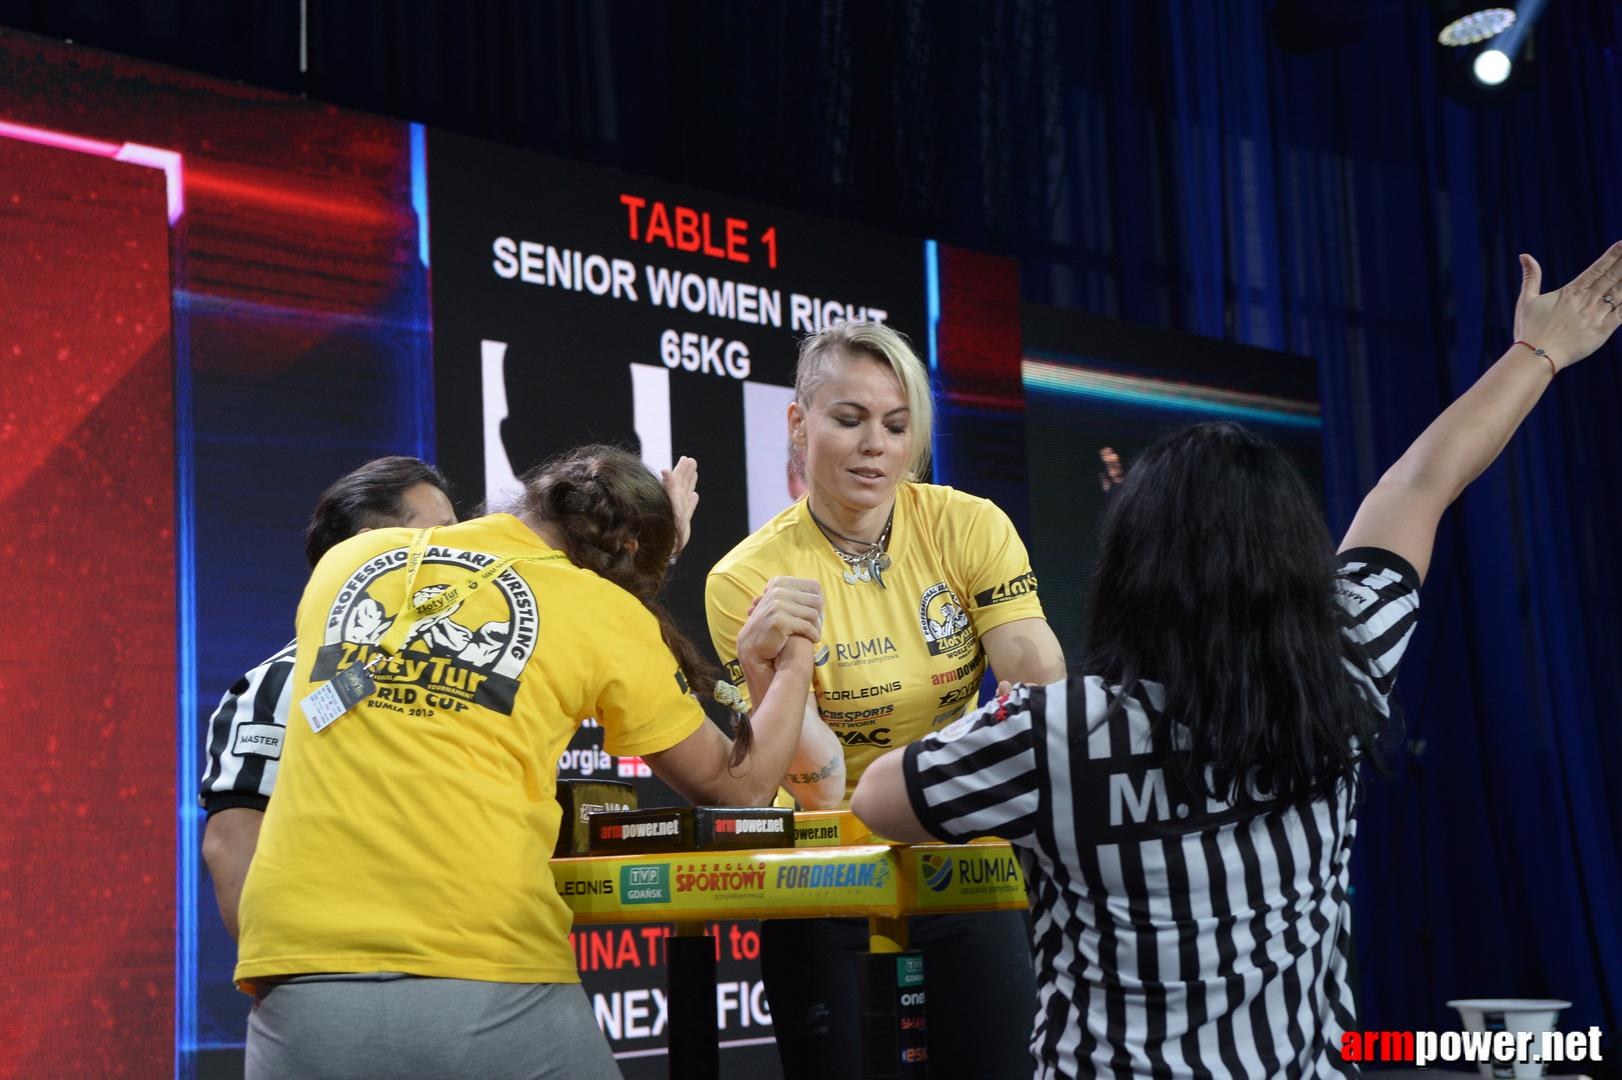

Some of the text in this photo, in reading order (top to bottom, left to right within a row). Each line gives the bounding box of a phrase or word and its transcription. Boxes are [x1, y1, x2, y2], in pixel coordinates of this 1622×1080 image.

[620, 194, 777, 269] TABLE 1
[492, 236, 638, 301] SENIOR
[645, 265, 782, 327] WOMEN
[659, 329, 751, 379] 65KG
[328, 547, 452, 628] PROFESSIOAL
[497, 569, 534, 661] WRESTLING
[835, 637, 897, 661] RUMIA
[367, 699, 405, 714] RUMIA
[425, 693, 470, 713] CUP
[240, 735, 280, 747] MASTER
[559, 744, 612, 776] orgia
[601, 820, 679, 840] armpower.net
[715, 817, 784, 834] armpower.net
[794, 825, 838, 840] ower.net
[632, 868, 658, 882] TVP
[676, 871, 766, 893] SPORTOWY
[777, 864, 877, 890] FORDREAM
[959, 857, 1018, 884] RUMIA
[730, 925, 760, 961] to
[593, 981, 774, 1040] NEX FIG
